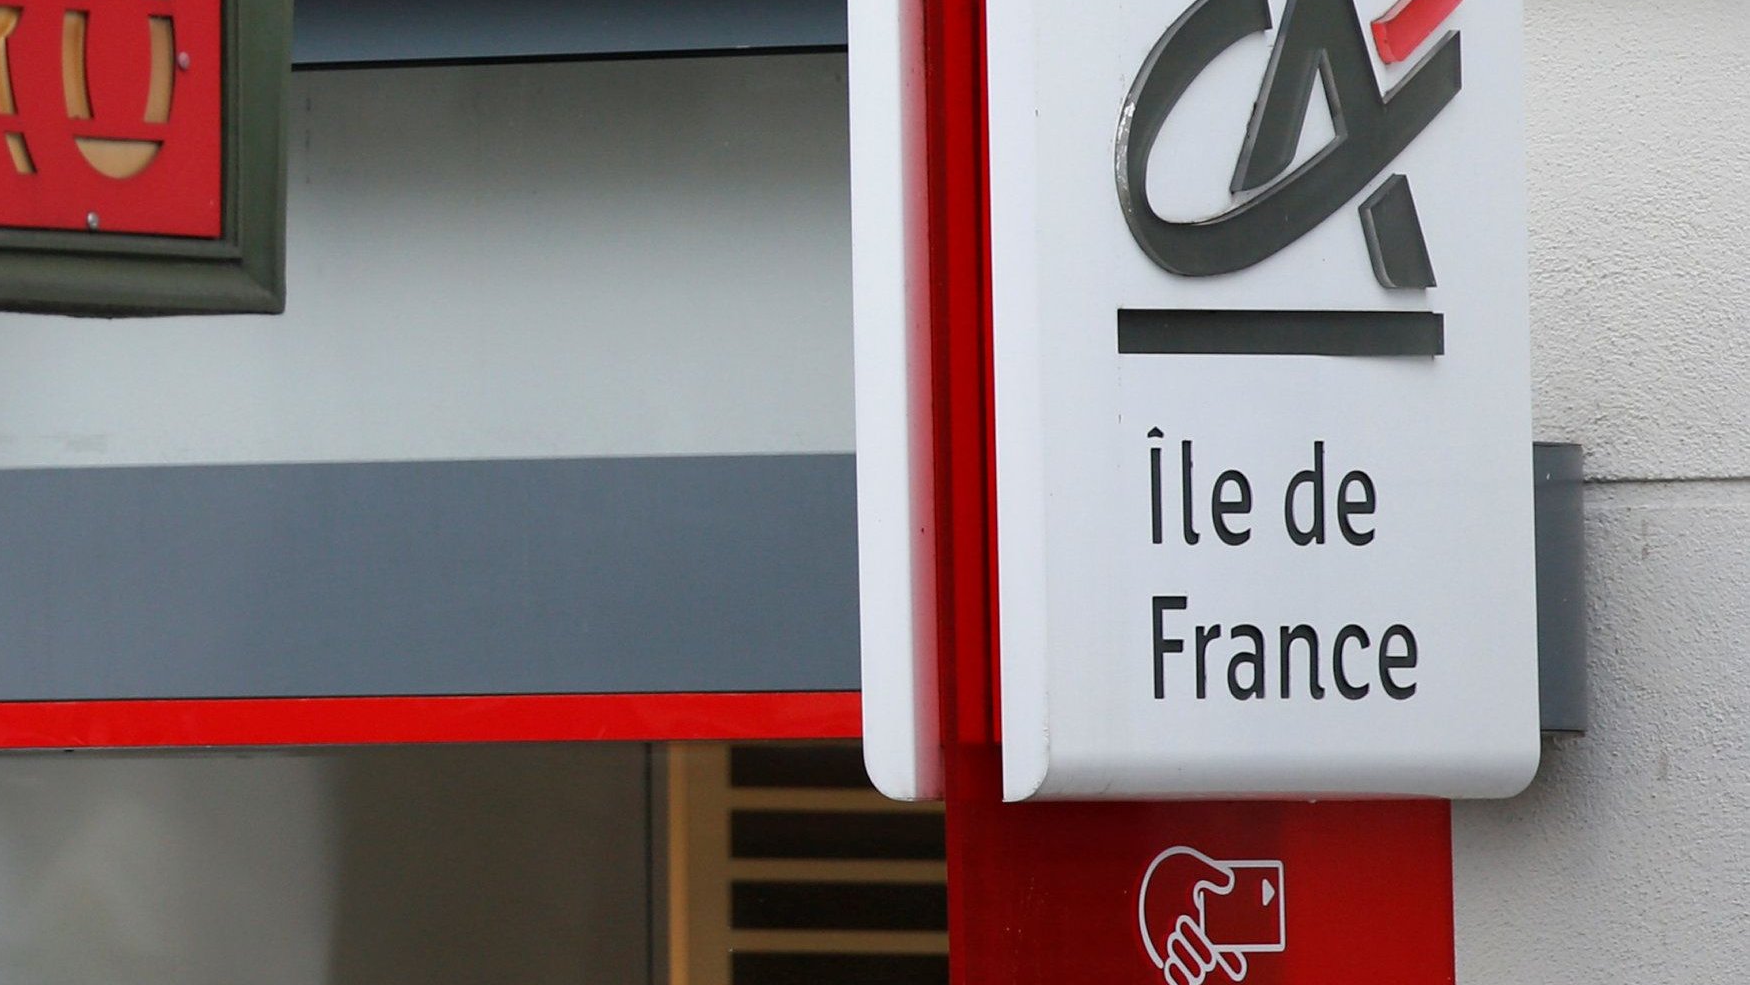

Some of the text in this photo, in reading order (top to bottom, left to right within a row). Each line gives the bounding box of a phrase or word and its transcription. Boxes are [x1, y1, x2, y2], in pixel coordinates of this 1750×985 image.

[1147, 427, 1377, 546] Île de
[1152, 594, 1419, 700] France
